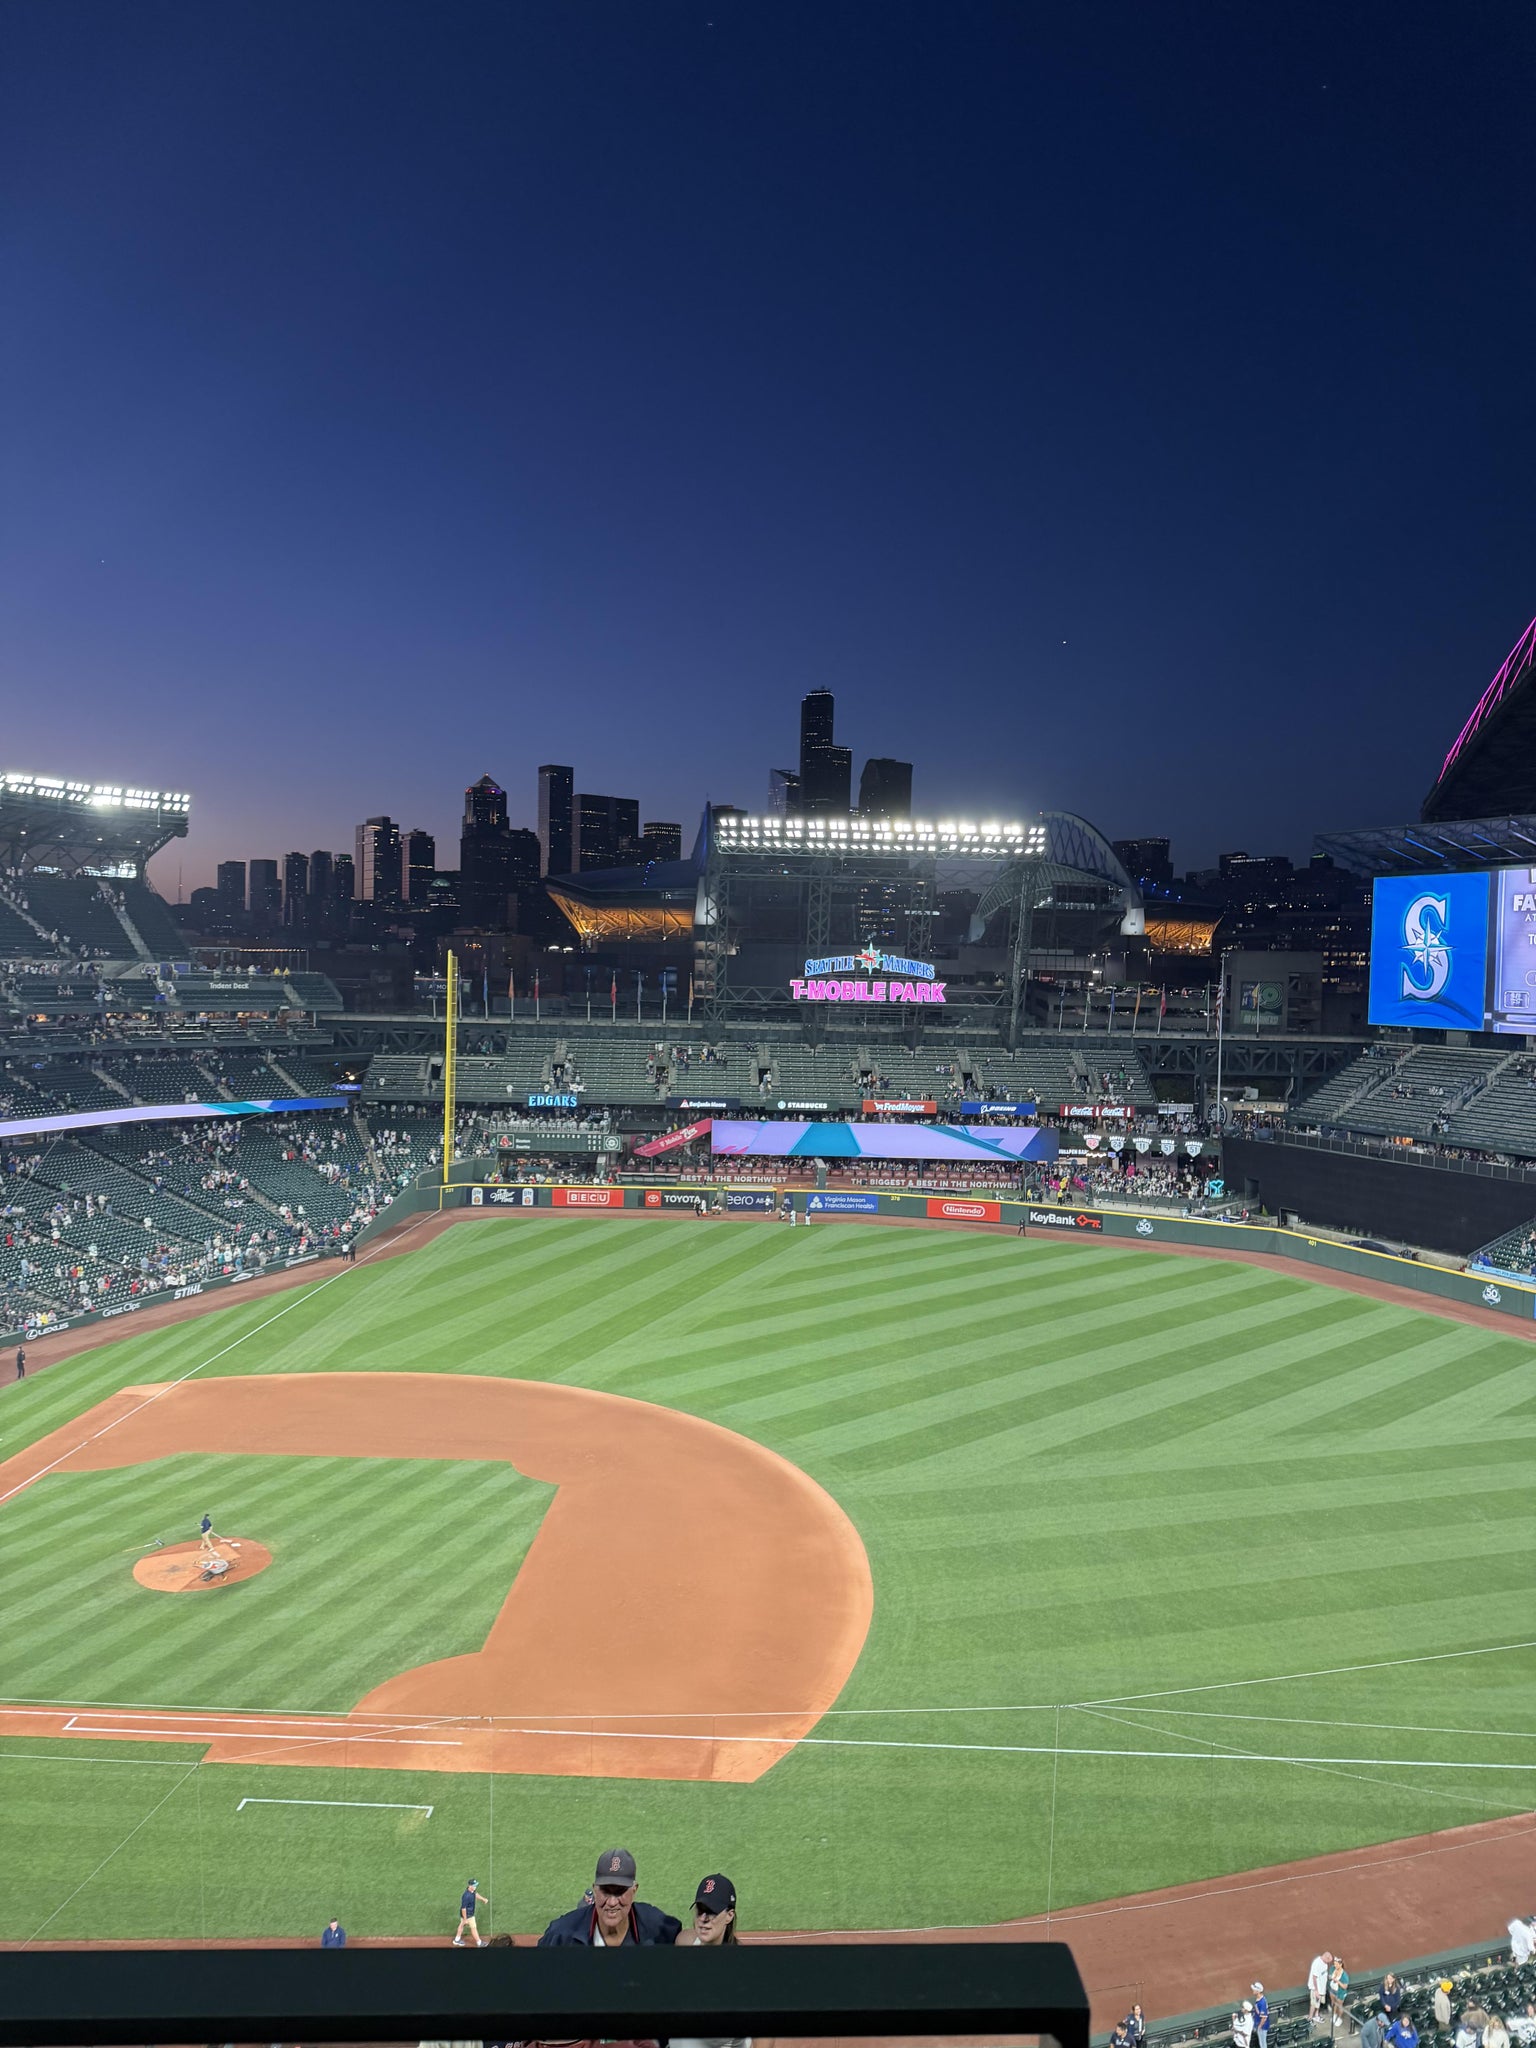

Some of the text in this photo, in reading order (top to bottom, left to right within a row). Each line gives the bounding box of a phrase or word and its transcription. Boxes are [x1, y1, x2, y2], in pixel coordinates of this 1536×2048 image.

[805, 954, 936, 980] SEATTLE MARINERS
[789, 980, 947, 1003] T-MOBILE PARK
[680, 1174, 702, 1182] BEST
[733, 1175, 787, 1183] NORTHWEST
[869, 1178, 906, 1186] BIGGEST
[950, 1180, 968, 1188] THE
[570, 1193, 607, 1202] BECU
[664, 1195, 700, 1204] TOYOTA
[727, 1195, 754, 1206] eero
[946, 1205, 981, 1215] Nintendo
[1029, 1211, 1076, 1225] KeyBank
[1139, 1220, 1151, 1230] 50
[173, 1284, 204, 1300] STIHL
[1486, 1288, 1498, 1298] 50
[102, 1302, 142, 1318] Great Clips
[38, 1322, 69, 1336] LEXUS
[610, 1856, 621, 1872] B
[703, 1879, 716, 1894] B
